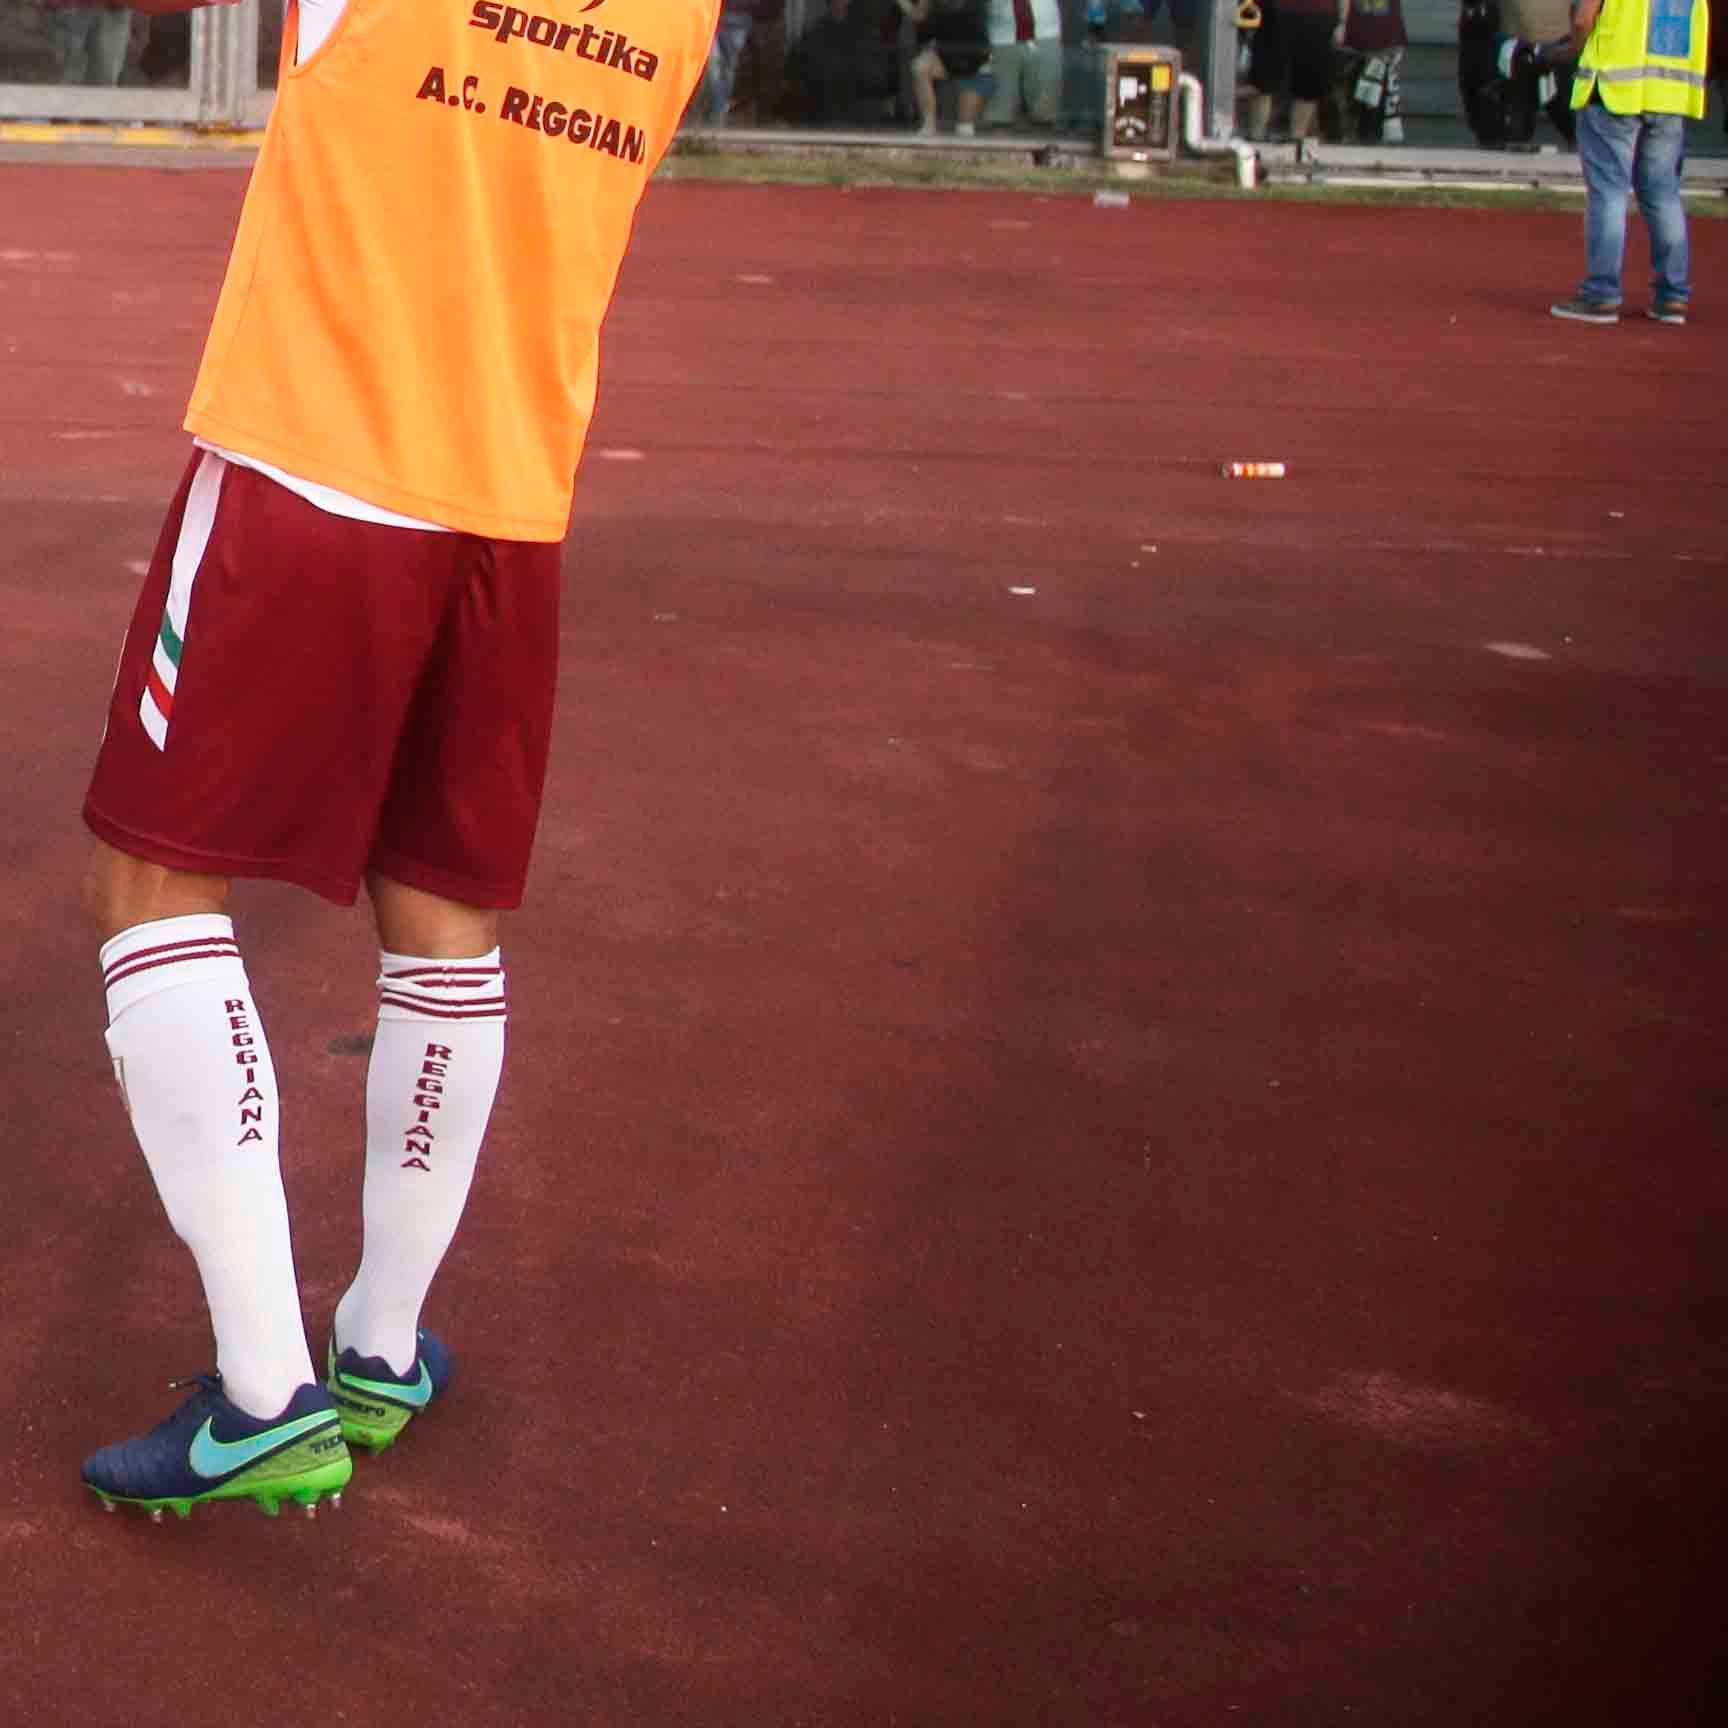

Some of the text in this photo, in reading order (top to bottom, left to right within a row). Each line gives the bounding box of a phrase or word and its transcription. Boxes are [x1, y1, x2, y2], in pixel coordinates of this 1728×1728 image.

[468, 0, 659, 82] sportika
[416, 66, 646, 166] A.C. REGGIAN
[225, 999, 264, 1147] REGGIANA
[401, 1042, 453, 1173] REGGIANA
